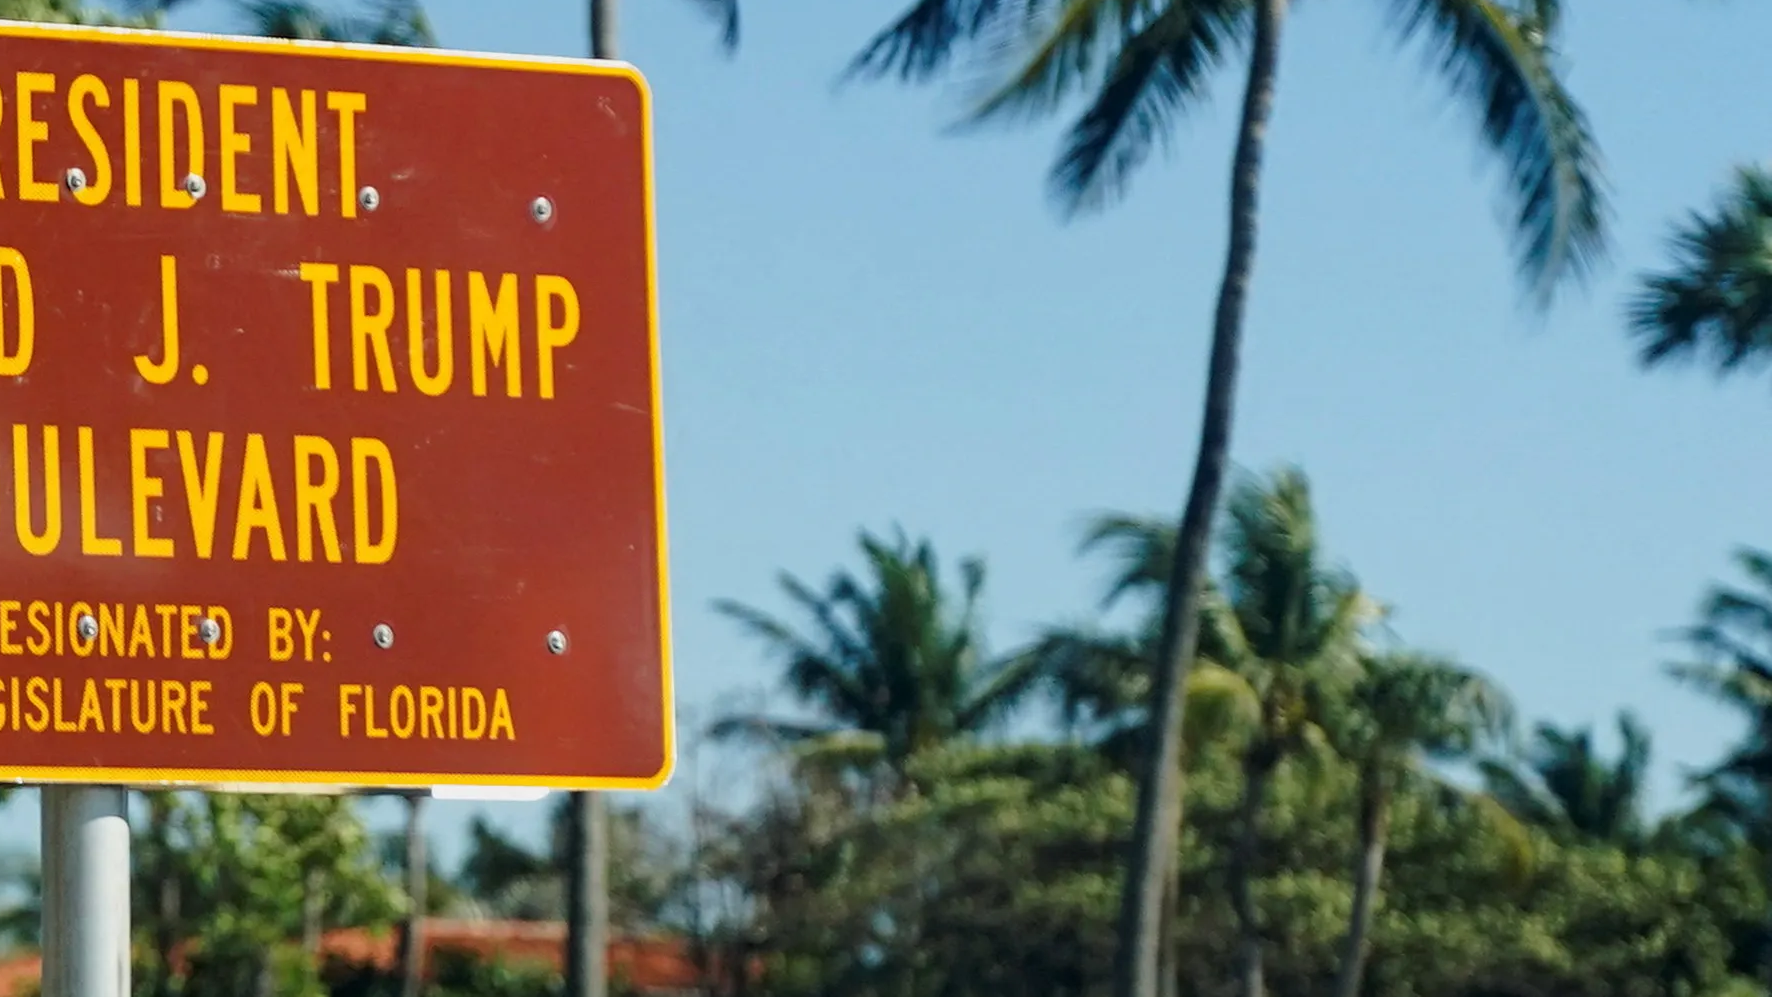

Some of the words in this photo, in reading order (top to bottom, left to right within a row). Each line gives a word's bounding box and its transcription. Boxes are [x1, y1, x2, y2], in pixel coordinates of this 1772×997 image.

[134, 256, 209, 385] J.
[300, 263, 581, 400] TRUMP
[269, 608, 332, 663] BY:
[251, 682, 304, 736] OF
[340, 685, 516, 741] FLORIDA
